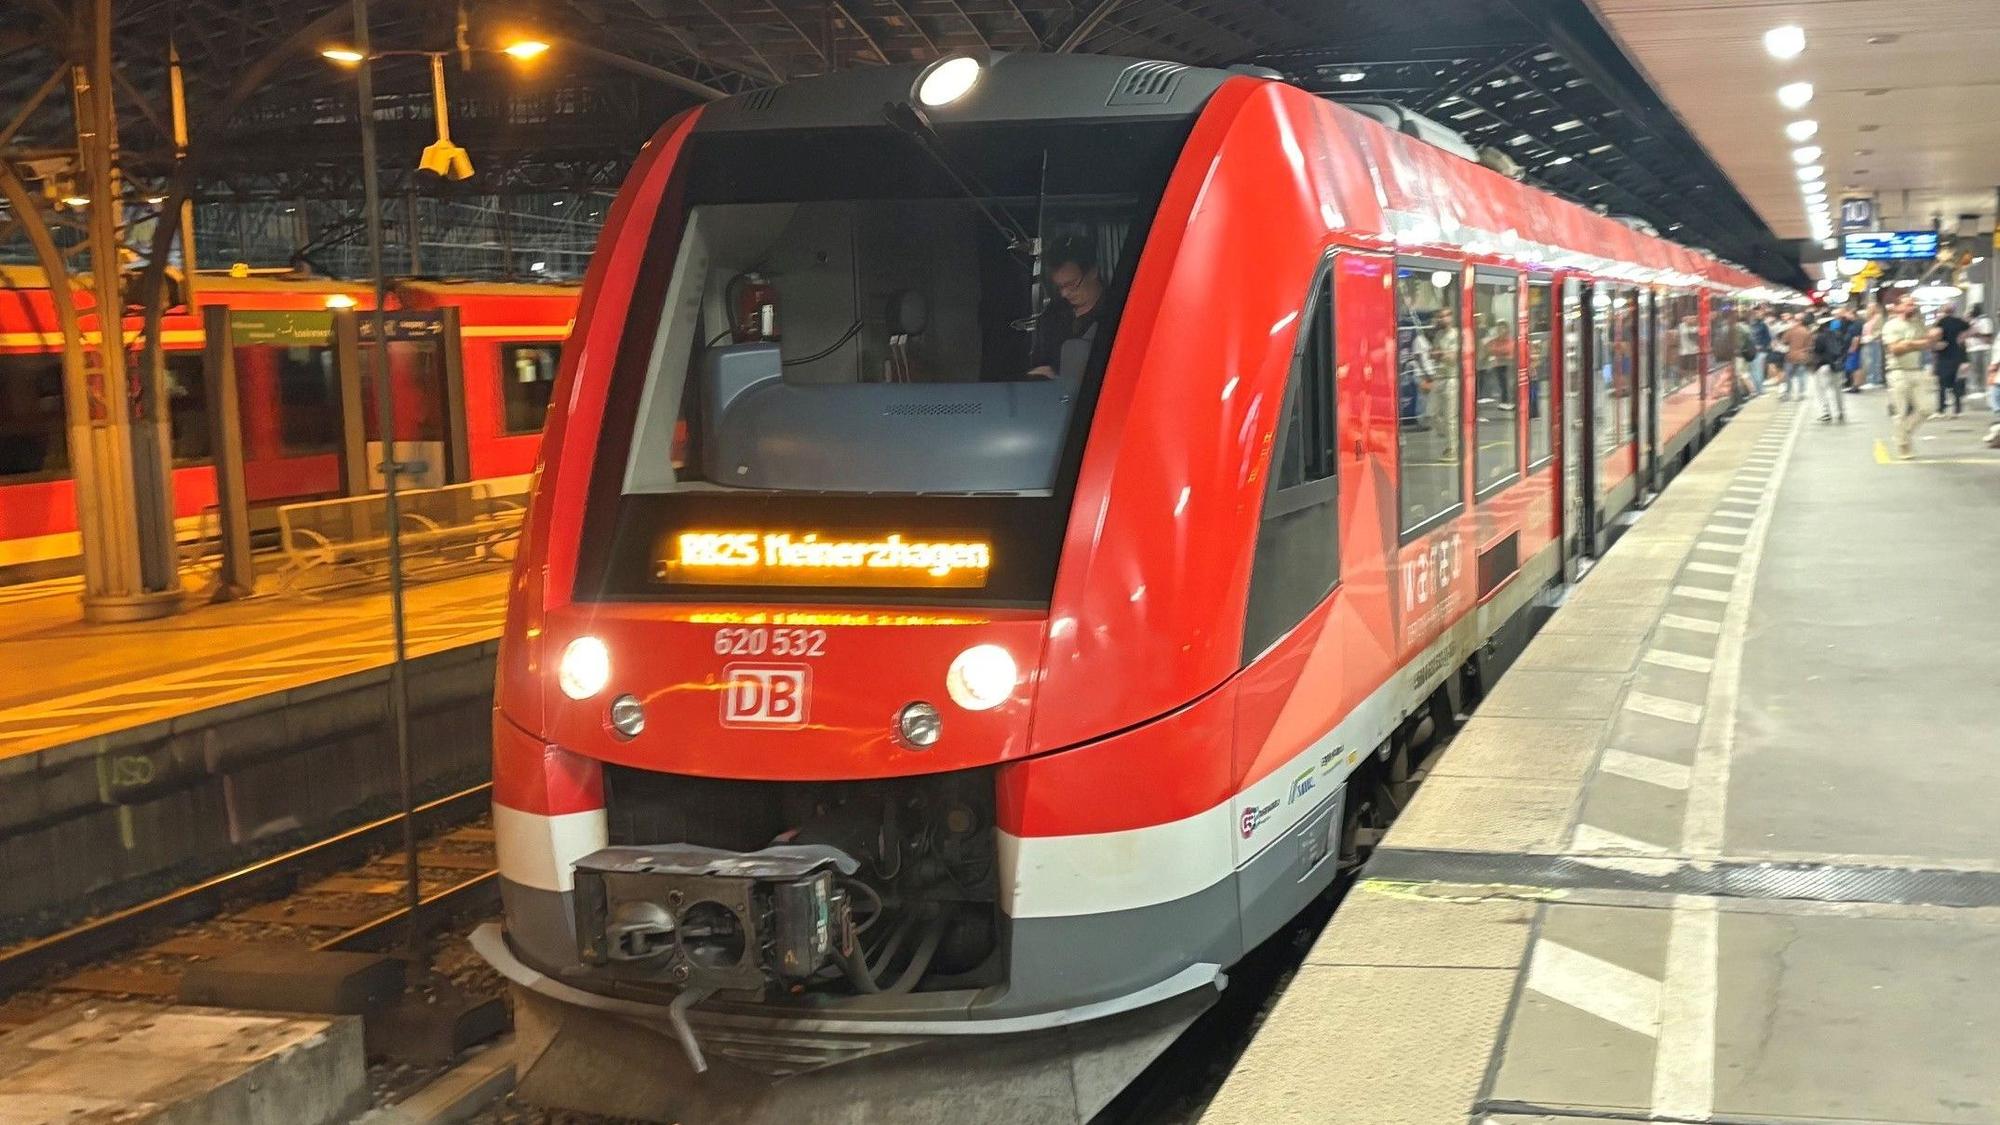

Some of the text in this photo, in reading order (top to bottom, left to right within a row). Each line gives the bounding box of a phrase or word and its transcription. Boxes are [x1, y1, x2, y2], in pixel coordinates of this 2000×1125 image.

[714, 627, 827, 657] 620 532
[730, 671, 800, 721] DB
